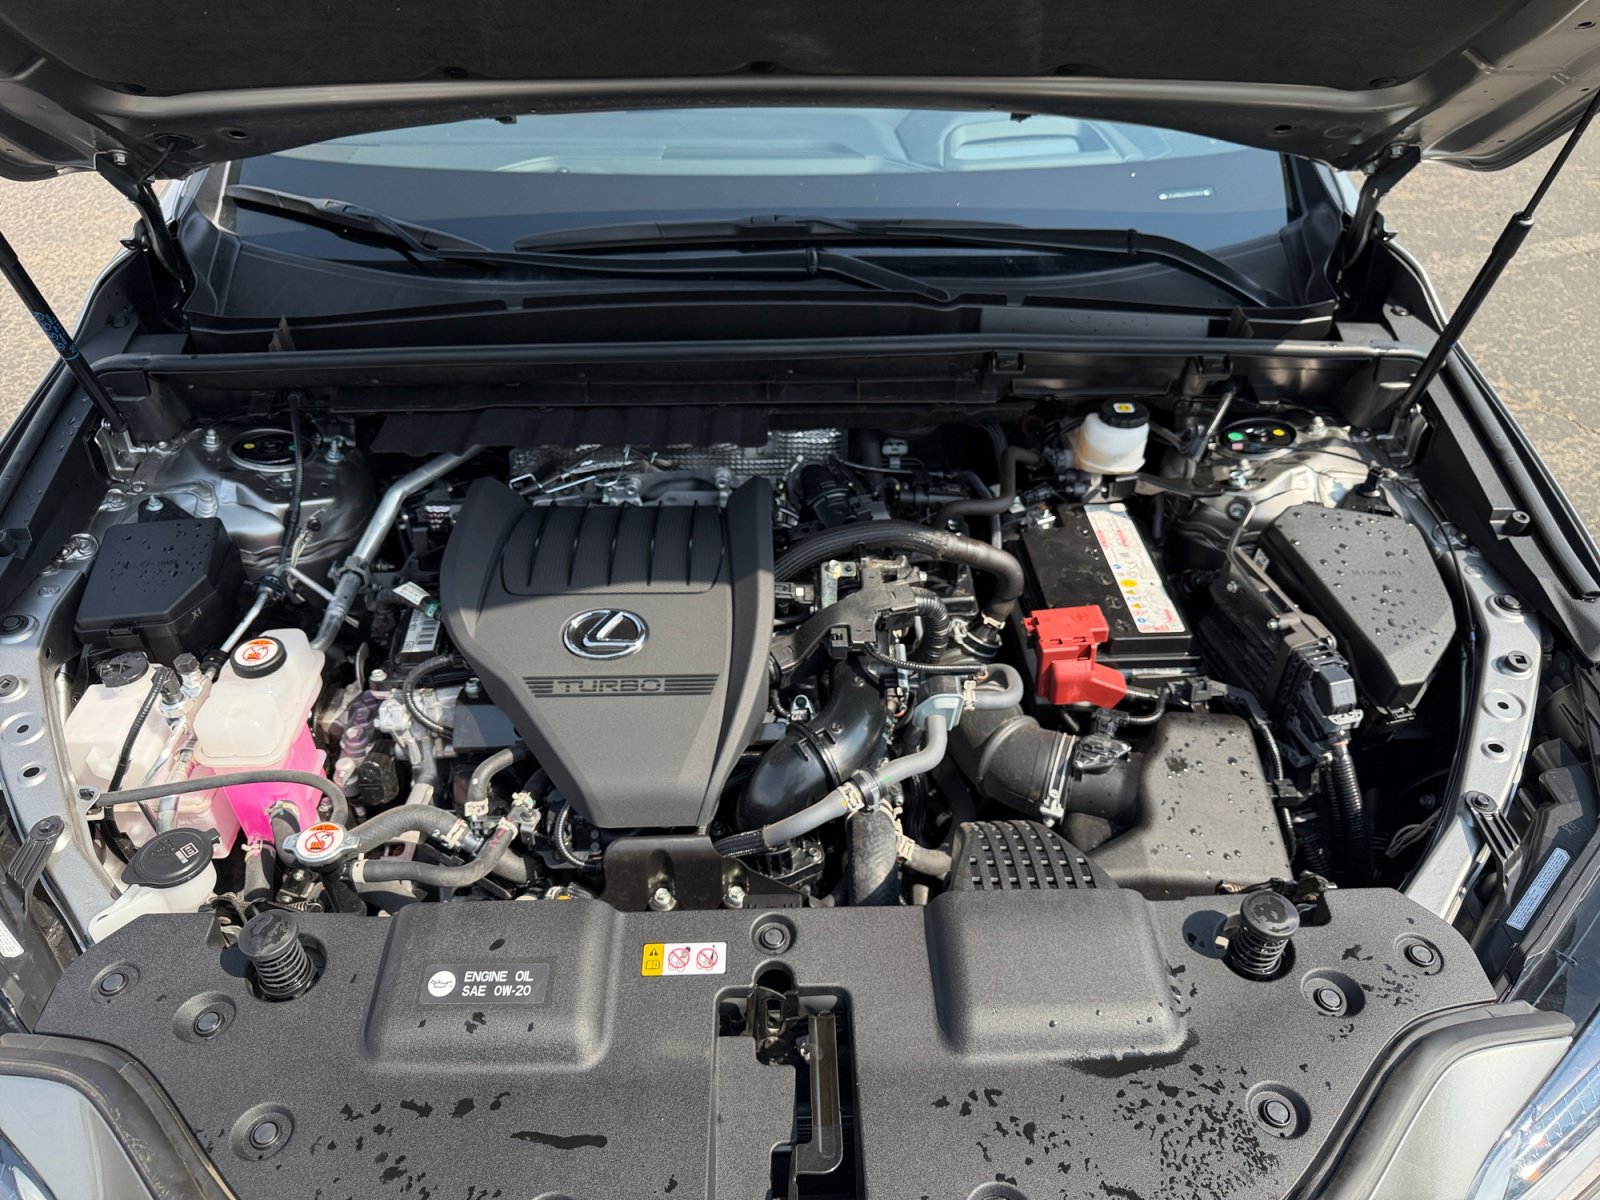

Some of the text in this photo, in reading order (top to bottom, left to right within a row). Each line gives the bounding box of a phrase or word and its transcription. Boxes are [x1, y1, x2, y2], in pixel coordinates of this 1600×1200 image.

[557, 679, 661, 693] TURBO
[464, 970, 534, 983] ENGINE OIL
[461, 984, 532, 997] SAE 0W-20
